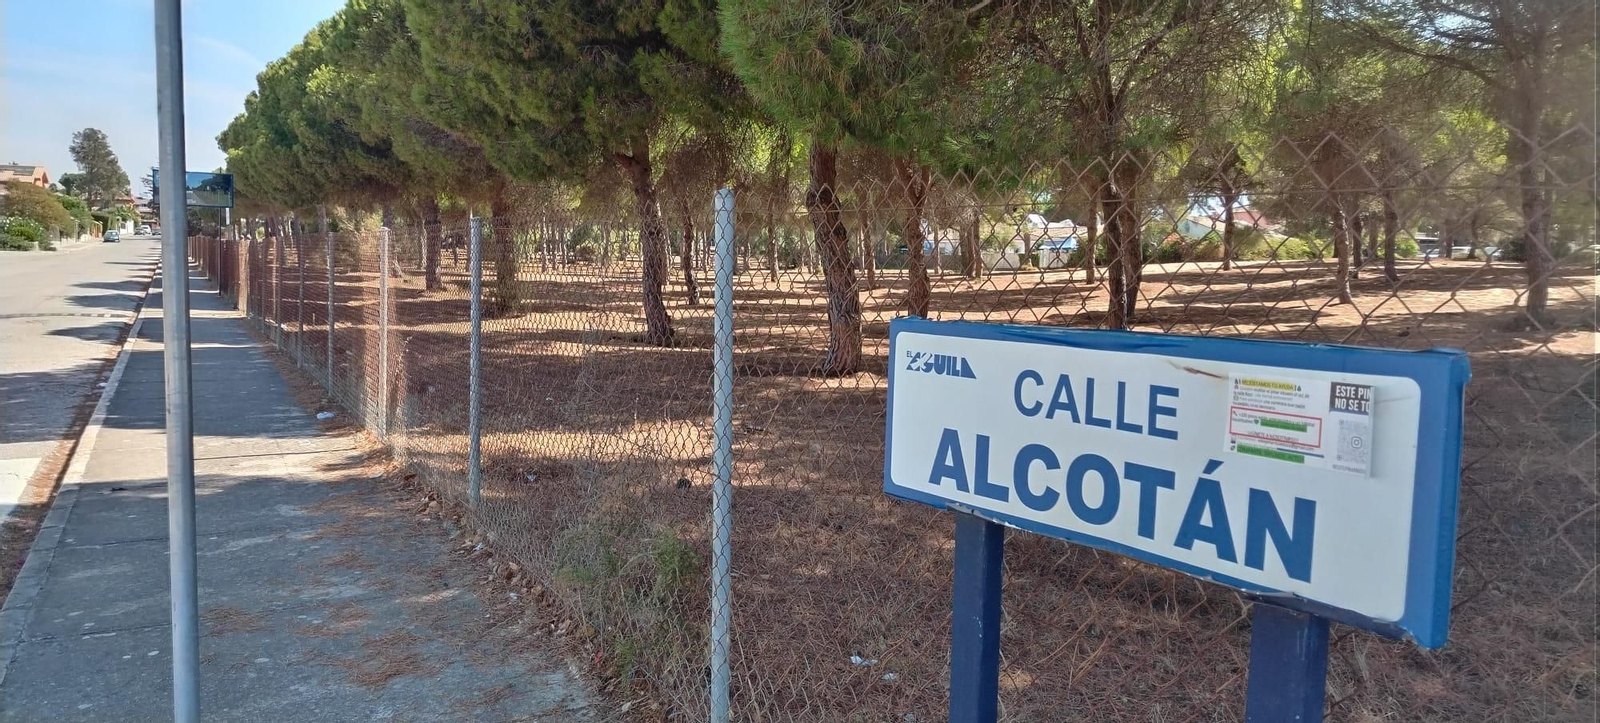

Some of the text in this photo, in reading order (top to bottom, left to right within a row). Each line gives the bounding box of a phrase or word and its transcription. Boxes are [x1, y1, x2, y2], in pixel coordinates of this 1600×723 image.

[906, 350, 913, 358] EL
[1336, 385, 1357, 398] ESTE
[1014, 369, 1179, 440] CALLE
[1334, 398, 1346, 410] NO
[1348, 400, 1360, 411] SE
[928, 428, 1317, 583] ALCOTÁN
